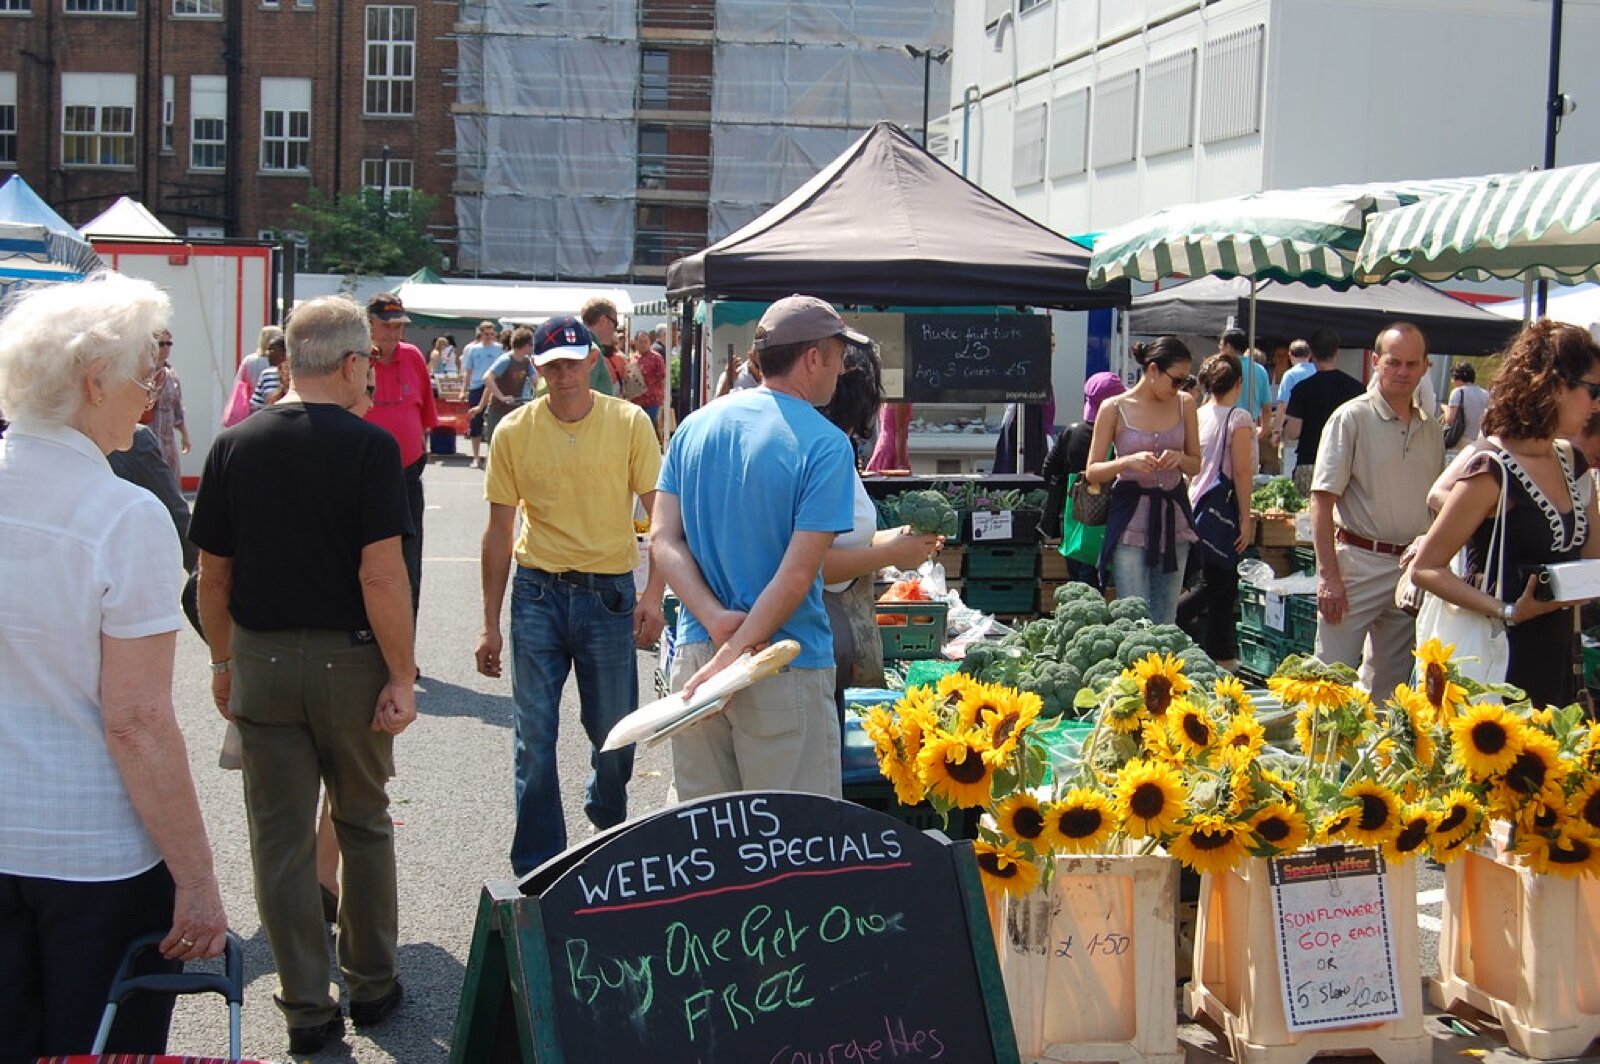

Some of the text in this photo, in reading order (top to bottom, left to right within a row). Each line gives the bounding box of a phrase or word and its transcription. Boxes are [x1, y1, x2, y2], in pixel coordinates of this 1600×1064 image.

[954, 341, 990, 360] £3
[677, 799, 780, 842] THIS
[577, 829, 903, 905] WEEKS SPECIALS
[1348, 925, 1382, 941] EACH
[564, 938, 655, 1016] Buy
[665, 920, 732, 977] One
[740, 904, 810, 966] Get
[1316, 957, 1338, 971] OR
[684, 963, 815, 1042] FREE
[1296, 980, 1312, 1009] 5
